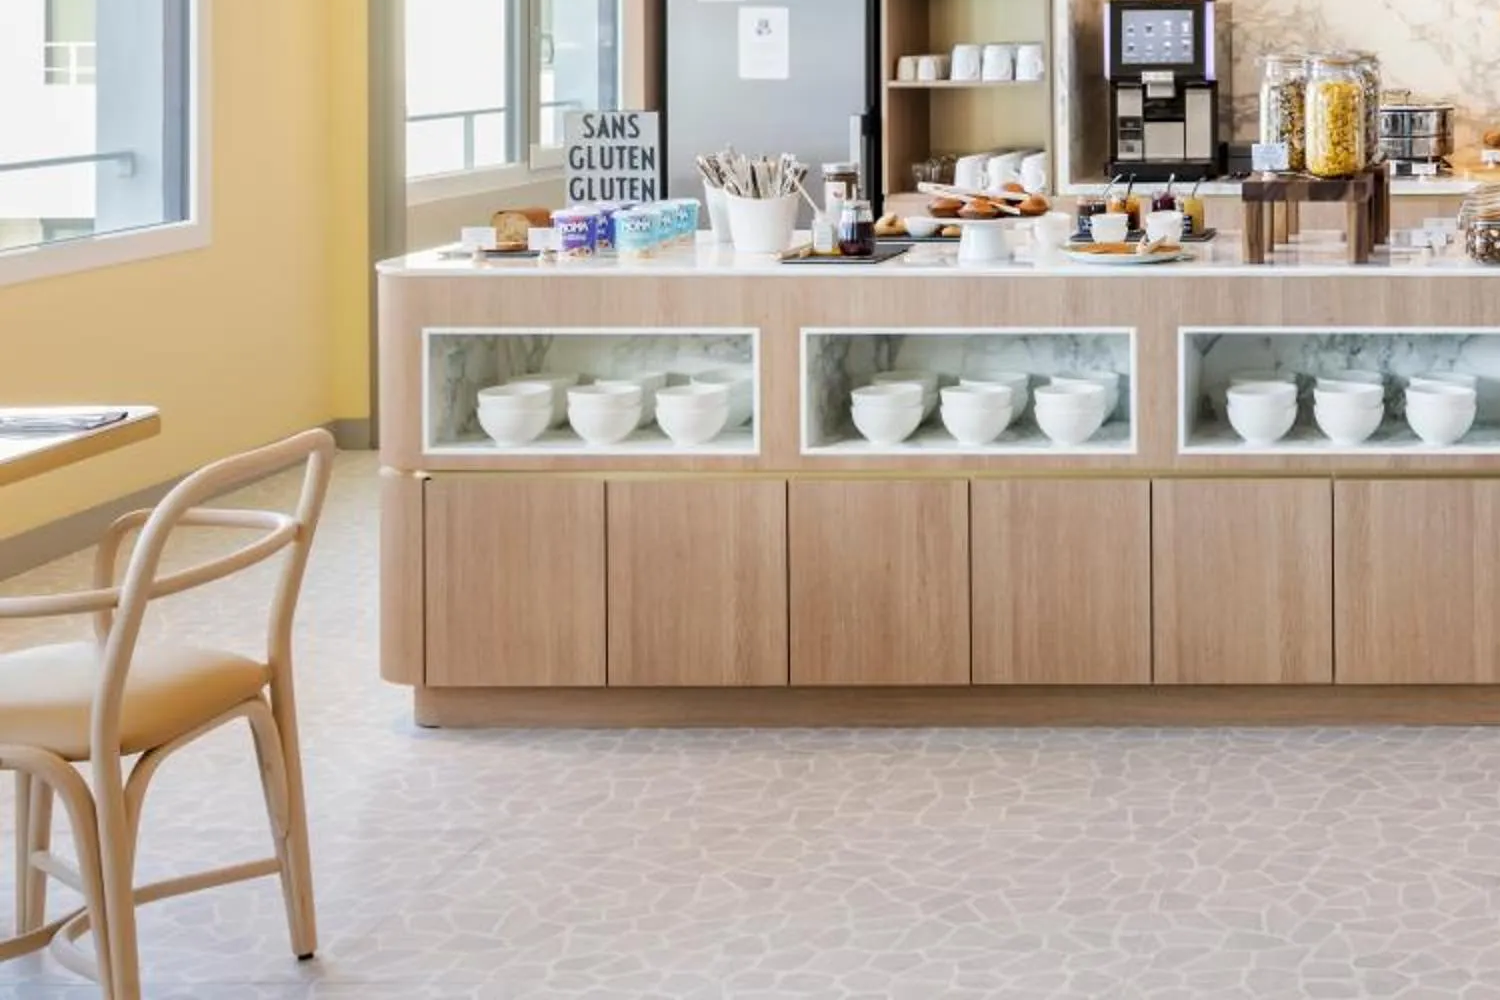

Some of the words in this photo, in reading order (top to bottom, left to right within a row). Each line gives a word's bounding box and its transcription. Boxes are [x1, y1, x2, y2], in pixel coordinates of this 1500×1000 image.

[582, 113, 640, 139] SANS
[569, 145, 655, 171] GLUTEN
[569, 176, 655, 202] GLUTEN
